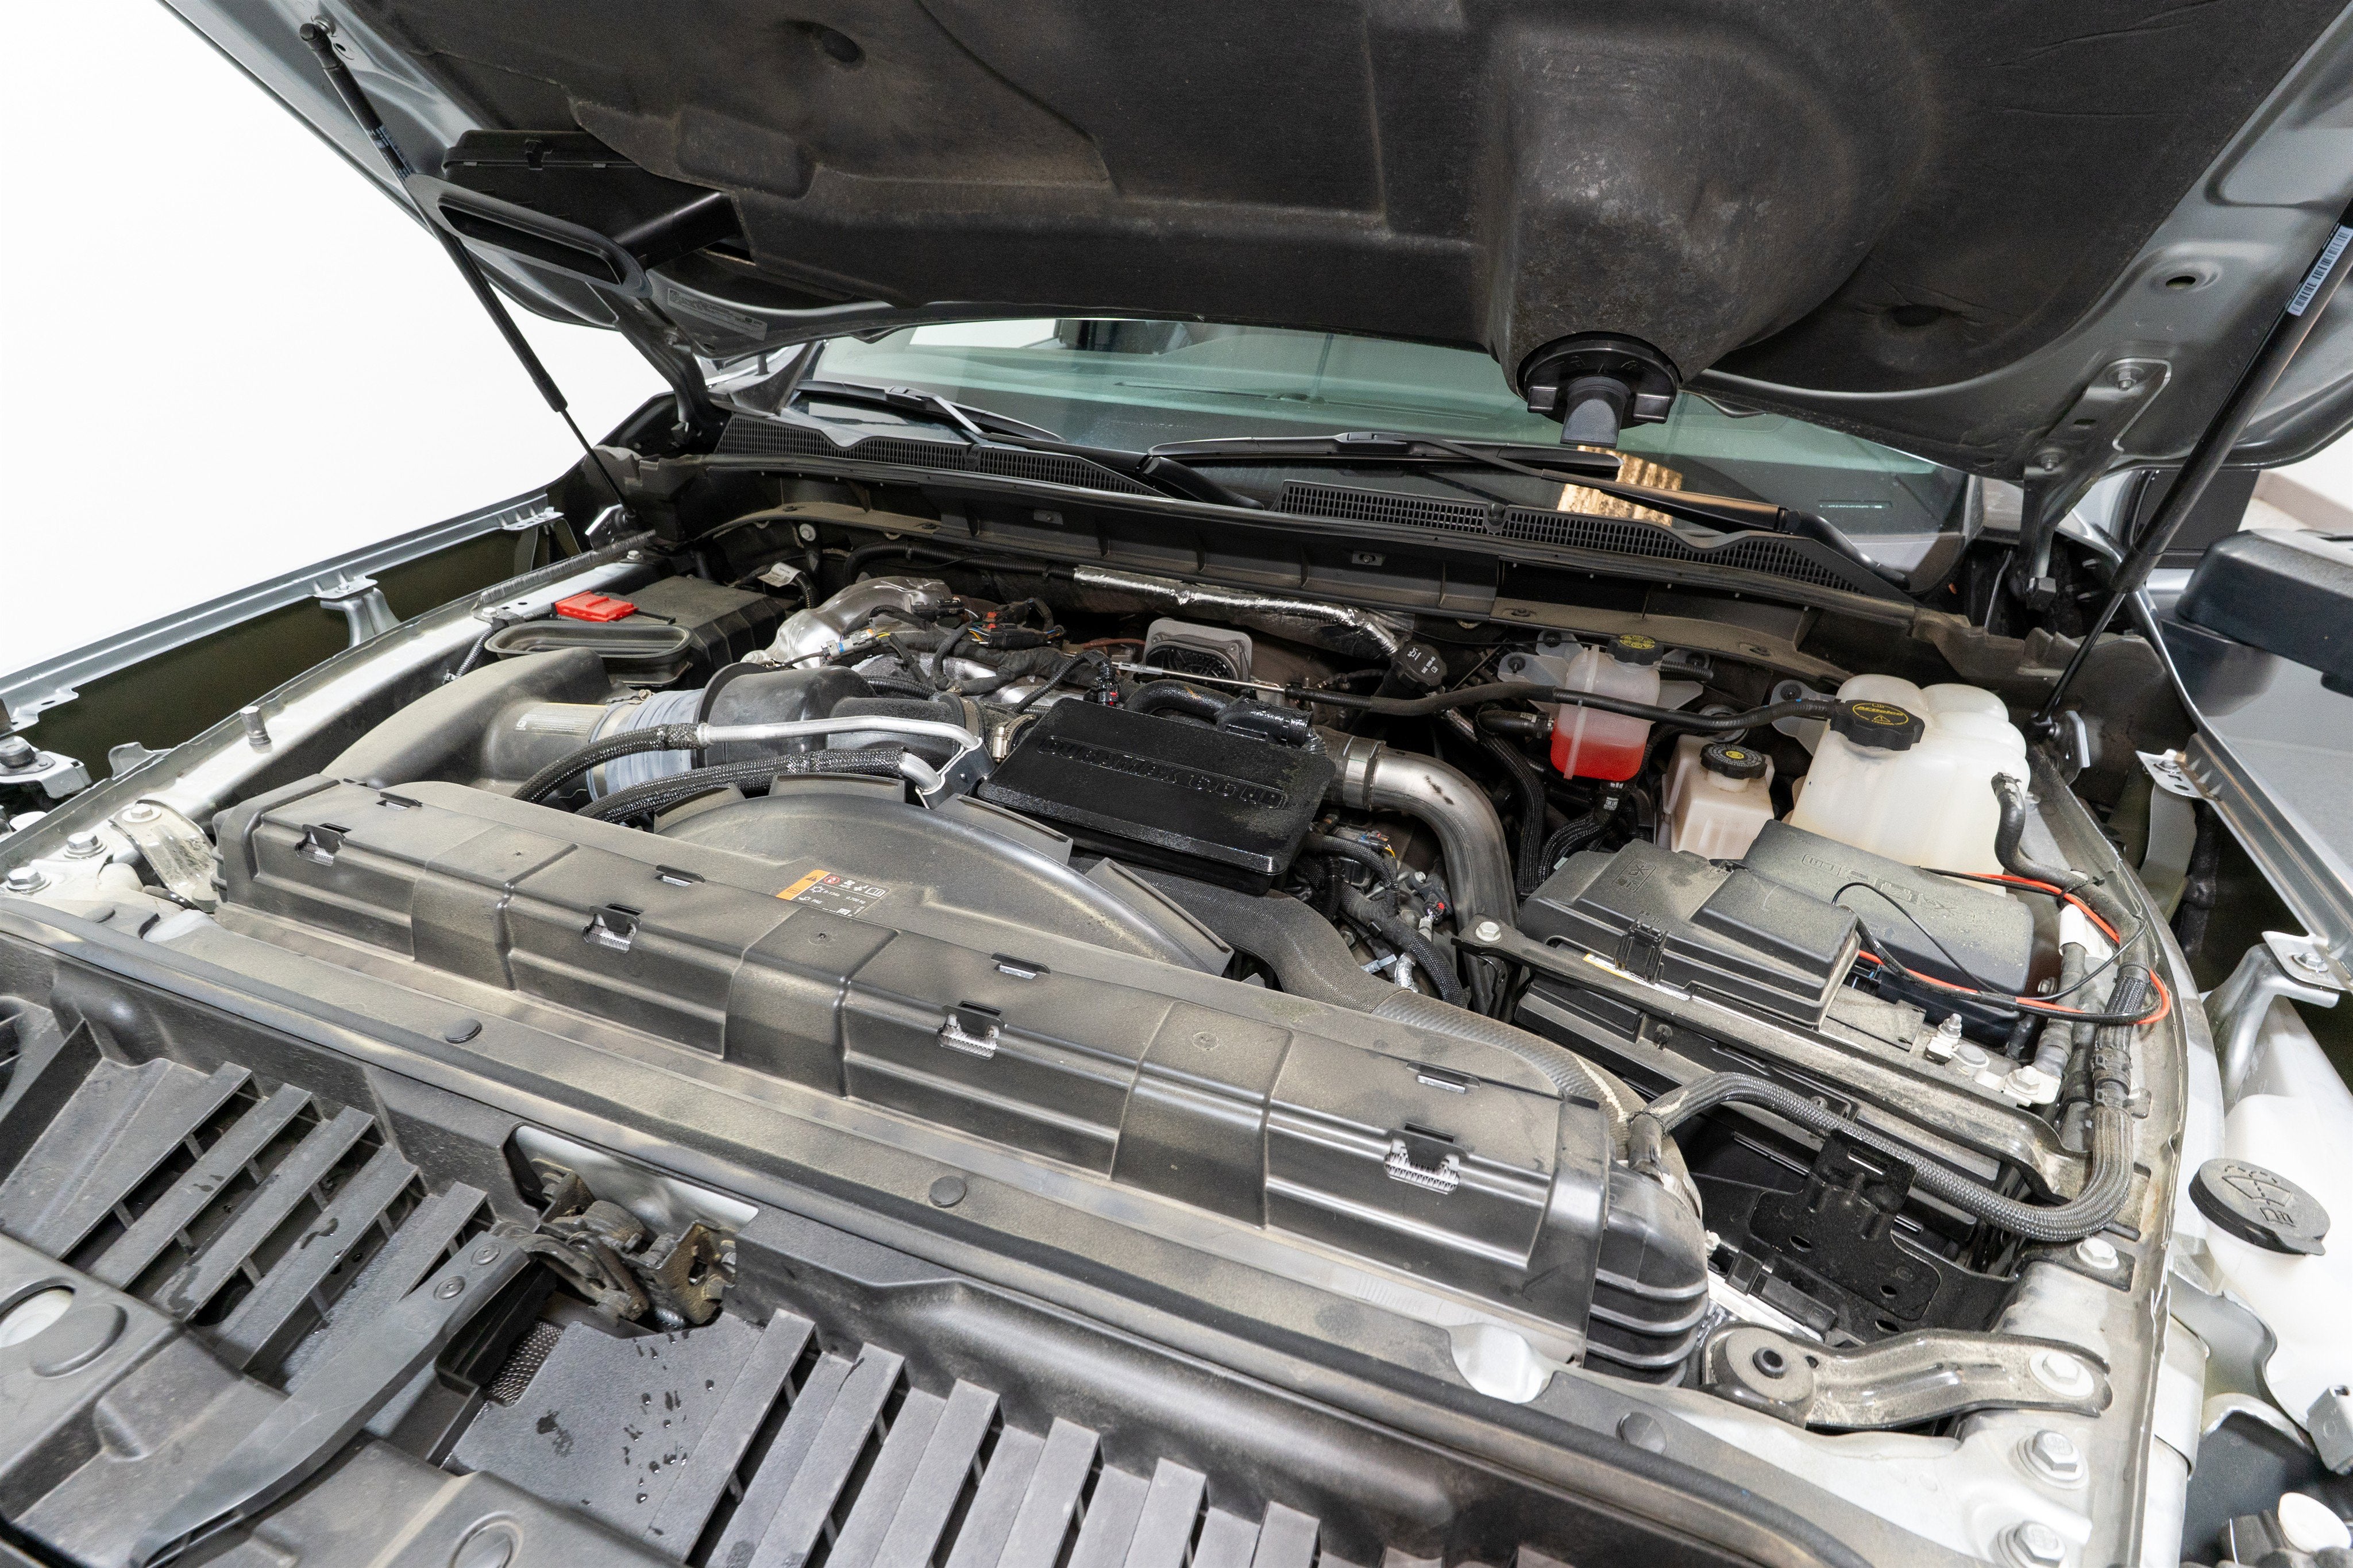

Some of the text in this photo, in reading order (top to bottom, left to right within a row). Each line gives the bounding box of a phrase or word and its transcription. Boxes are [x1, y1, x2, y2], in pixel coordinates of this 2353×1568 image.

[1039, 737, 1283, 809] DURAMAX 6.6 HD
